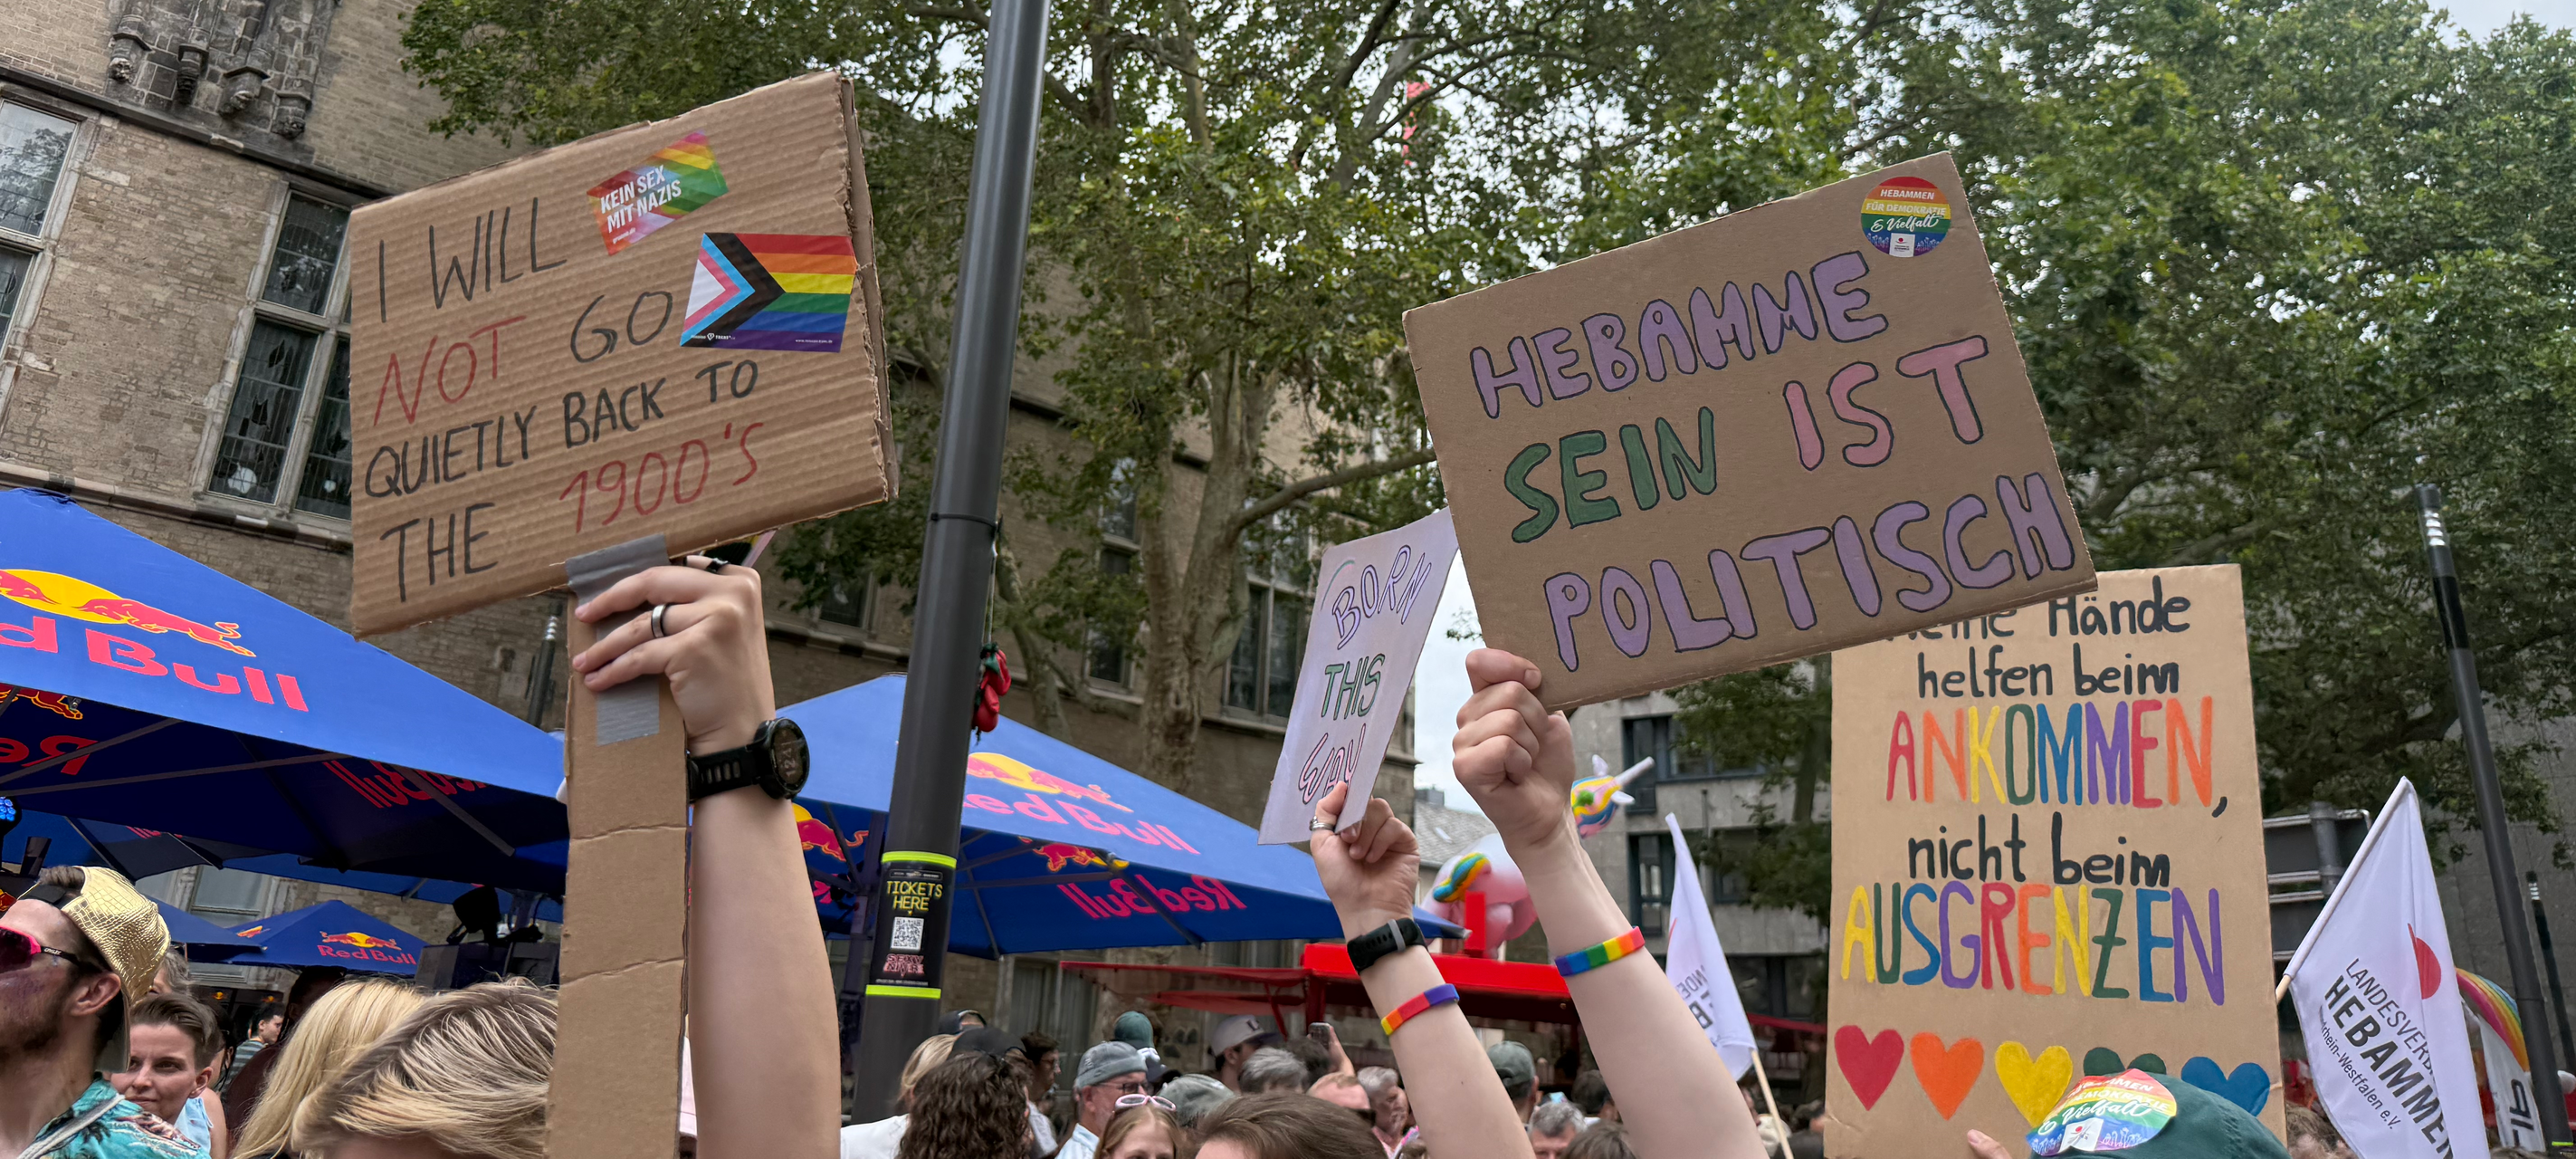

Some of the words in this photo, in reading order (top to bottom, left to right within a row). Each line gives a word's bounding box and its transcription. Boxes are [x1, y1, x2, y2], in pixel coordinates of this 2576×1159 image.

[601, 182, 635, 214] KEIN
[636, 165, 665, 194] SEX
[606, 204, 634, 233] MIT
[636, 180, 682, 216] NAZIS
[1865, 201, 1884, 211] FÜR
[1886, 204, 1946, 216] DEMOKRATIE
[1880, 189, 1935, 200] HEBAMMEN
[1886, 214, 1941, 232] Vielfalt
[378, 238, 387, 323] I
[429, 196, 568, 311] WILL
[374, 315, 528, 426] NOT
[569, 291, 673, 363] GO
[1470, 250, 1889, 419] HEBAMME
[364, 405, 537, 499] QUIETLY
[562, 377, 667, 450] BACK
[695, 359, 758, 402] TO
[1503, 406, 1718, 543] SEIN
[1782, 334, 1989, 471] IST
[380, 502, 498, 603] THE
[559, 422, 765, 534] 1900'S
[1331, 544, 1432, 651] BORN
[1543, 472, 2075, 672] POLITISCH
[2048, 575, 2190, 637] Hände
[85, 628, 309, 712] Bull
[1321, 653, 1386, 721] THIS
[1917, 644, 2053, 698] helfen
[2073, 642, 2180, 695] beim
[1298, 723, 1366, 805] WAY
[1885, 695, 2228, 818] ANKOMMEN,
[963, 793, 1069, 825] ed
[1055, 800, 1201, 855] Bull
[1908, 813, 2027, 882] nicht
[2051, 811, 2170, 887] beim
[887, 881, 943, 898] TICKETS
[892, 896, 930, 912] HERE
[317, 945, 369, 960] Red
[370, 949, 416, 964] Bull
[1840, 880, 2225, 1006] AUSGRENZEN
[2062, 1099, 2152, 1125] Vielfalt
[2380, 1107, 2401, 1130] e.V.
